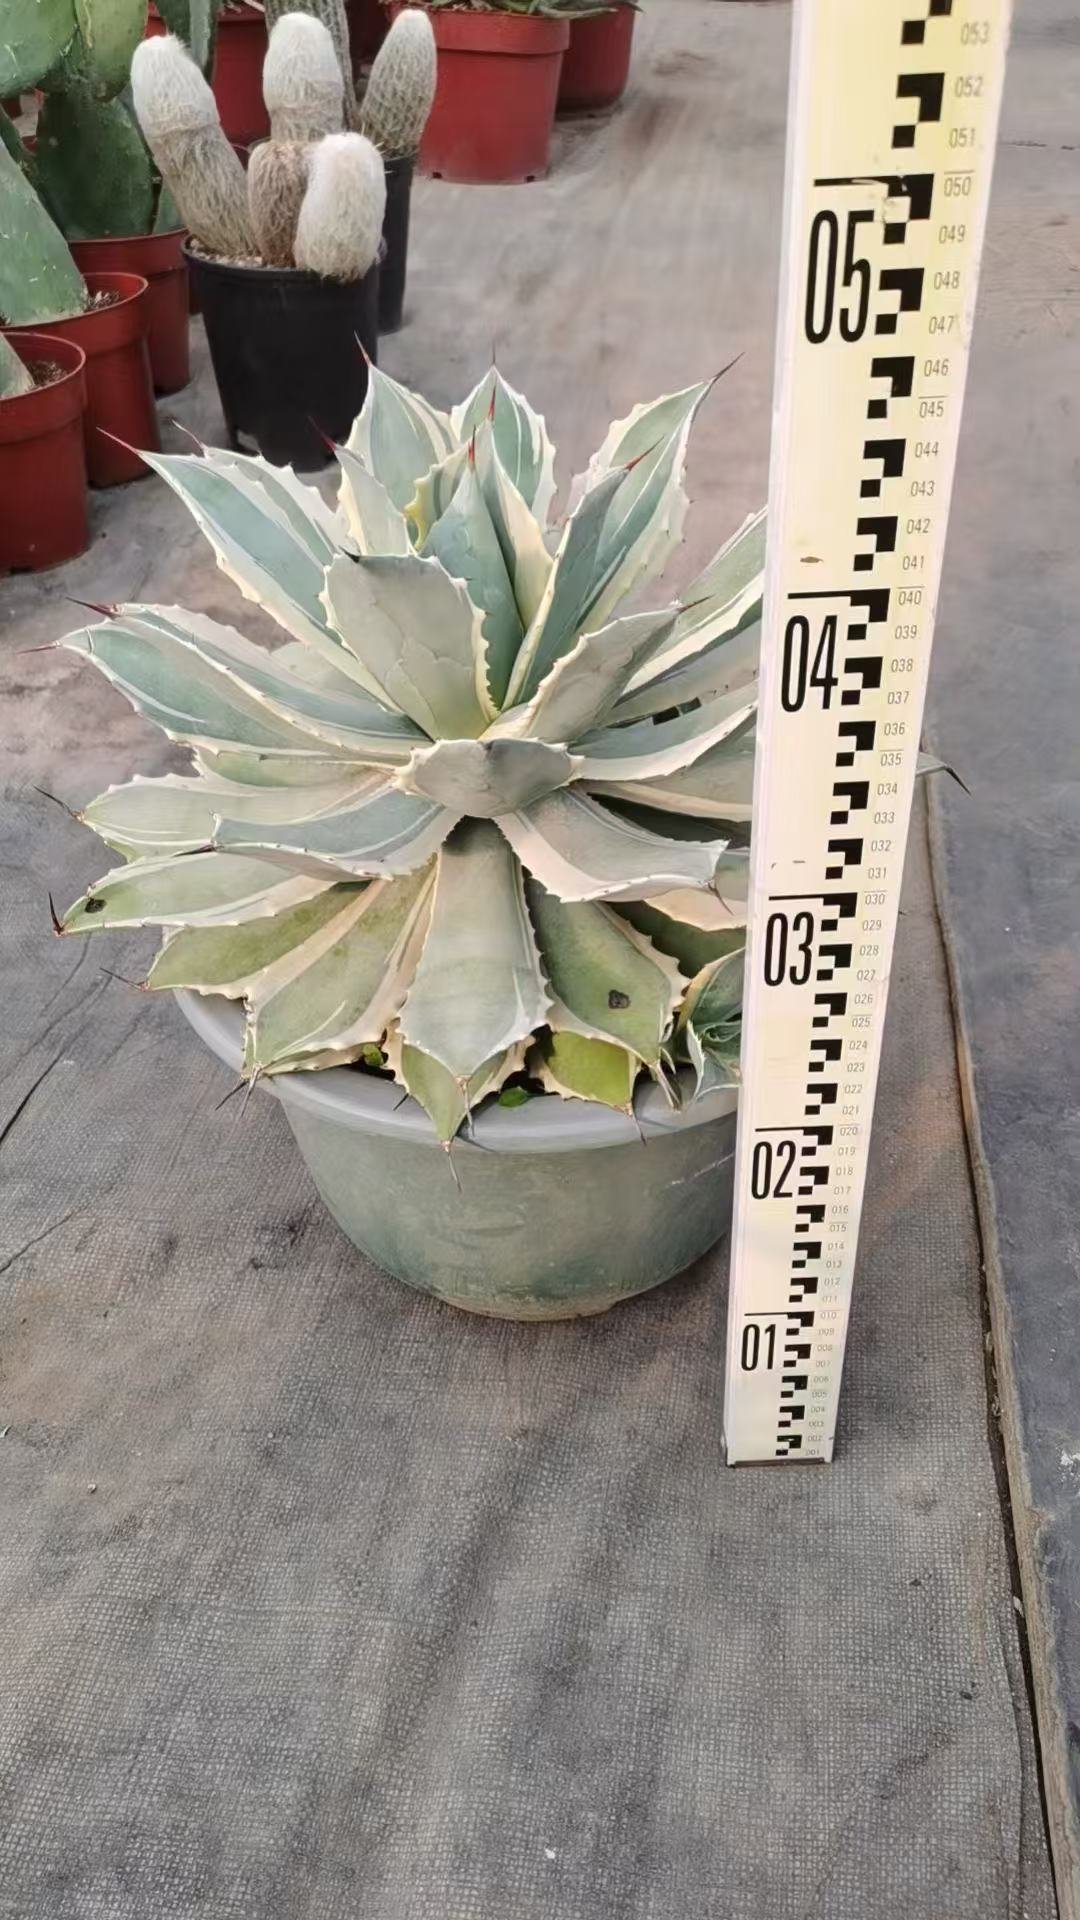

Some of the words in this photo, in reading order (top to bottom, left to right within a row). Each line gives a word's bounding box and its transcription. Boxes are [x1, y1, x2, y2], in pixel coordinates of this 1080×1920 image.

[960, 21, 990, 45] 053
[954, 76, 984, 98] 052
[948, 127, 976, 148] 051
[943, 176, 971, 197] 050
[938, 224, 965, 244] 049
[805, 210, 875, 344] 05
[933, 271, 960, 290] 048
[928, 315, 954, 334] 047
[923, 358, 949, 377] 046
[919, 400, 944, 418] 045
[914, 441, 939, 458] 044
[910, 480, 935, 497] 043
[906, 518, 931, 535] 042
[902, 555, 925, 570] 041
[898, 590, 922, 606] 040
[894, 624, 917, 640] 039
[781, 615, 839, 713] 04
[891, 658, 913, 673] 038
[887, 691, 910, 705] 037
[884, 722, 905, 736] 036
[880, 752, 902, 766] 035
[877, 782, 898, 795] 034
[873, 811, 895, 824] 033
[870, 839, 891, 852] 032
[867, 867, 887, 879] 031
[865, 893, 885, 905] 030
[862, 919, 882, 931] 029
[764, 911, 814, 987] 03
[859, 945, 879, 956] 028
[856, 970, 876, 981] 027
[854, 993, 873, 1004] 026
[851, 1017, 871, 1028] 025
[849, 1040, 867, 1050] 024
[847, 1062, 865, 1072] 023
[844, 1084, 862, 1094] 022
[842, 1105, 859, 1115] 021
[839, 1126, 858, 1136] 020
[837, 1146, 856, 1156] 019
[751, 1140, 796, 1199] 02
[835, 1166, 853, 1176] 018
[833, 1186, 851, 1195] 017
[831, 1205, 849, 1214] 016
[829, 1223, 847, 1232] 015
[827, 1242, 844, 1251] 014
[826, 1260, 842, 1268] 013
[823, 1277, 840, 1286] 012
[740, 1323, 776, 1372] 01
